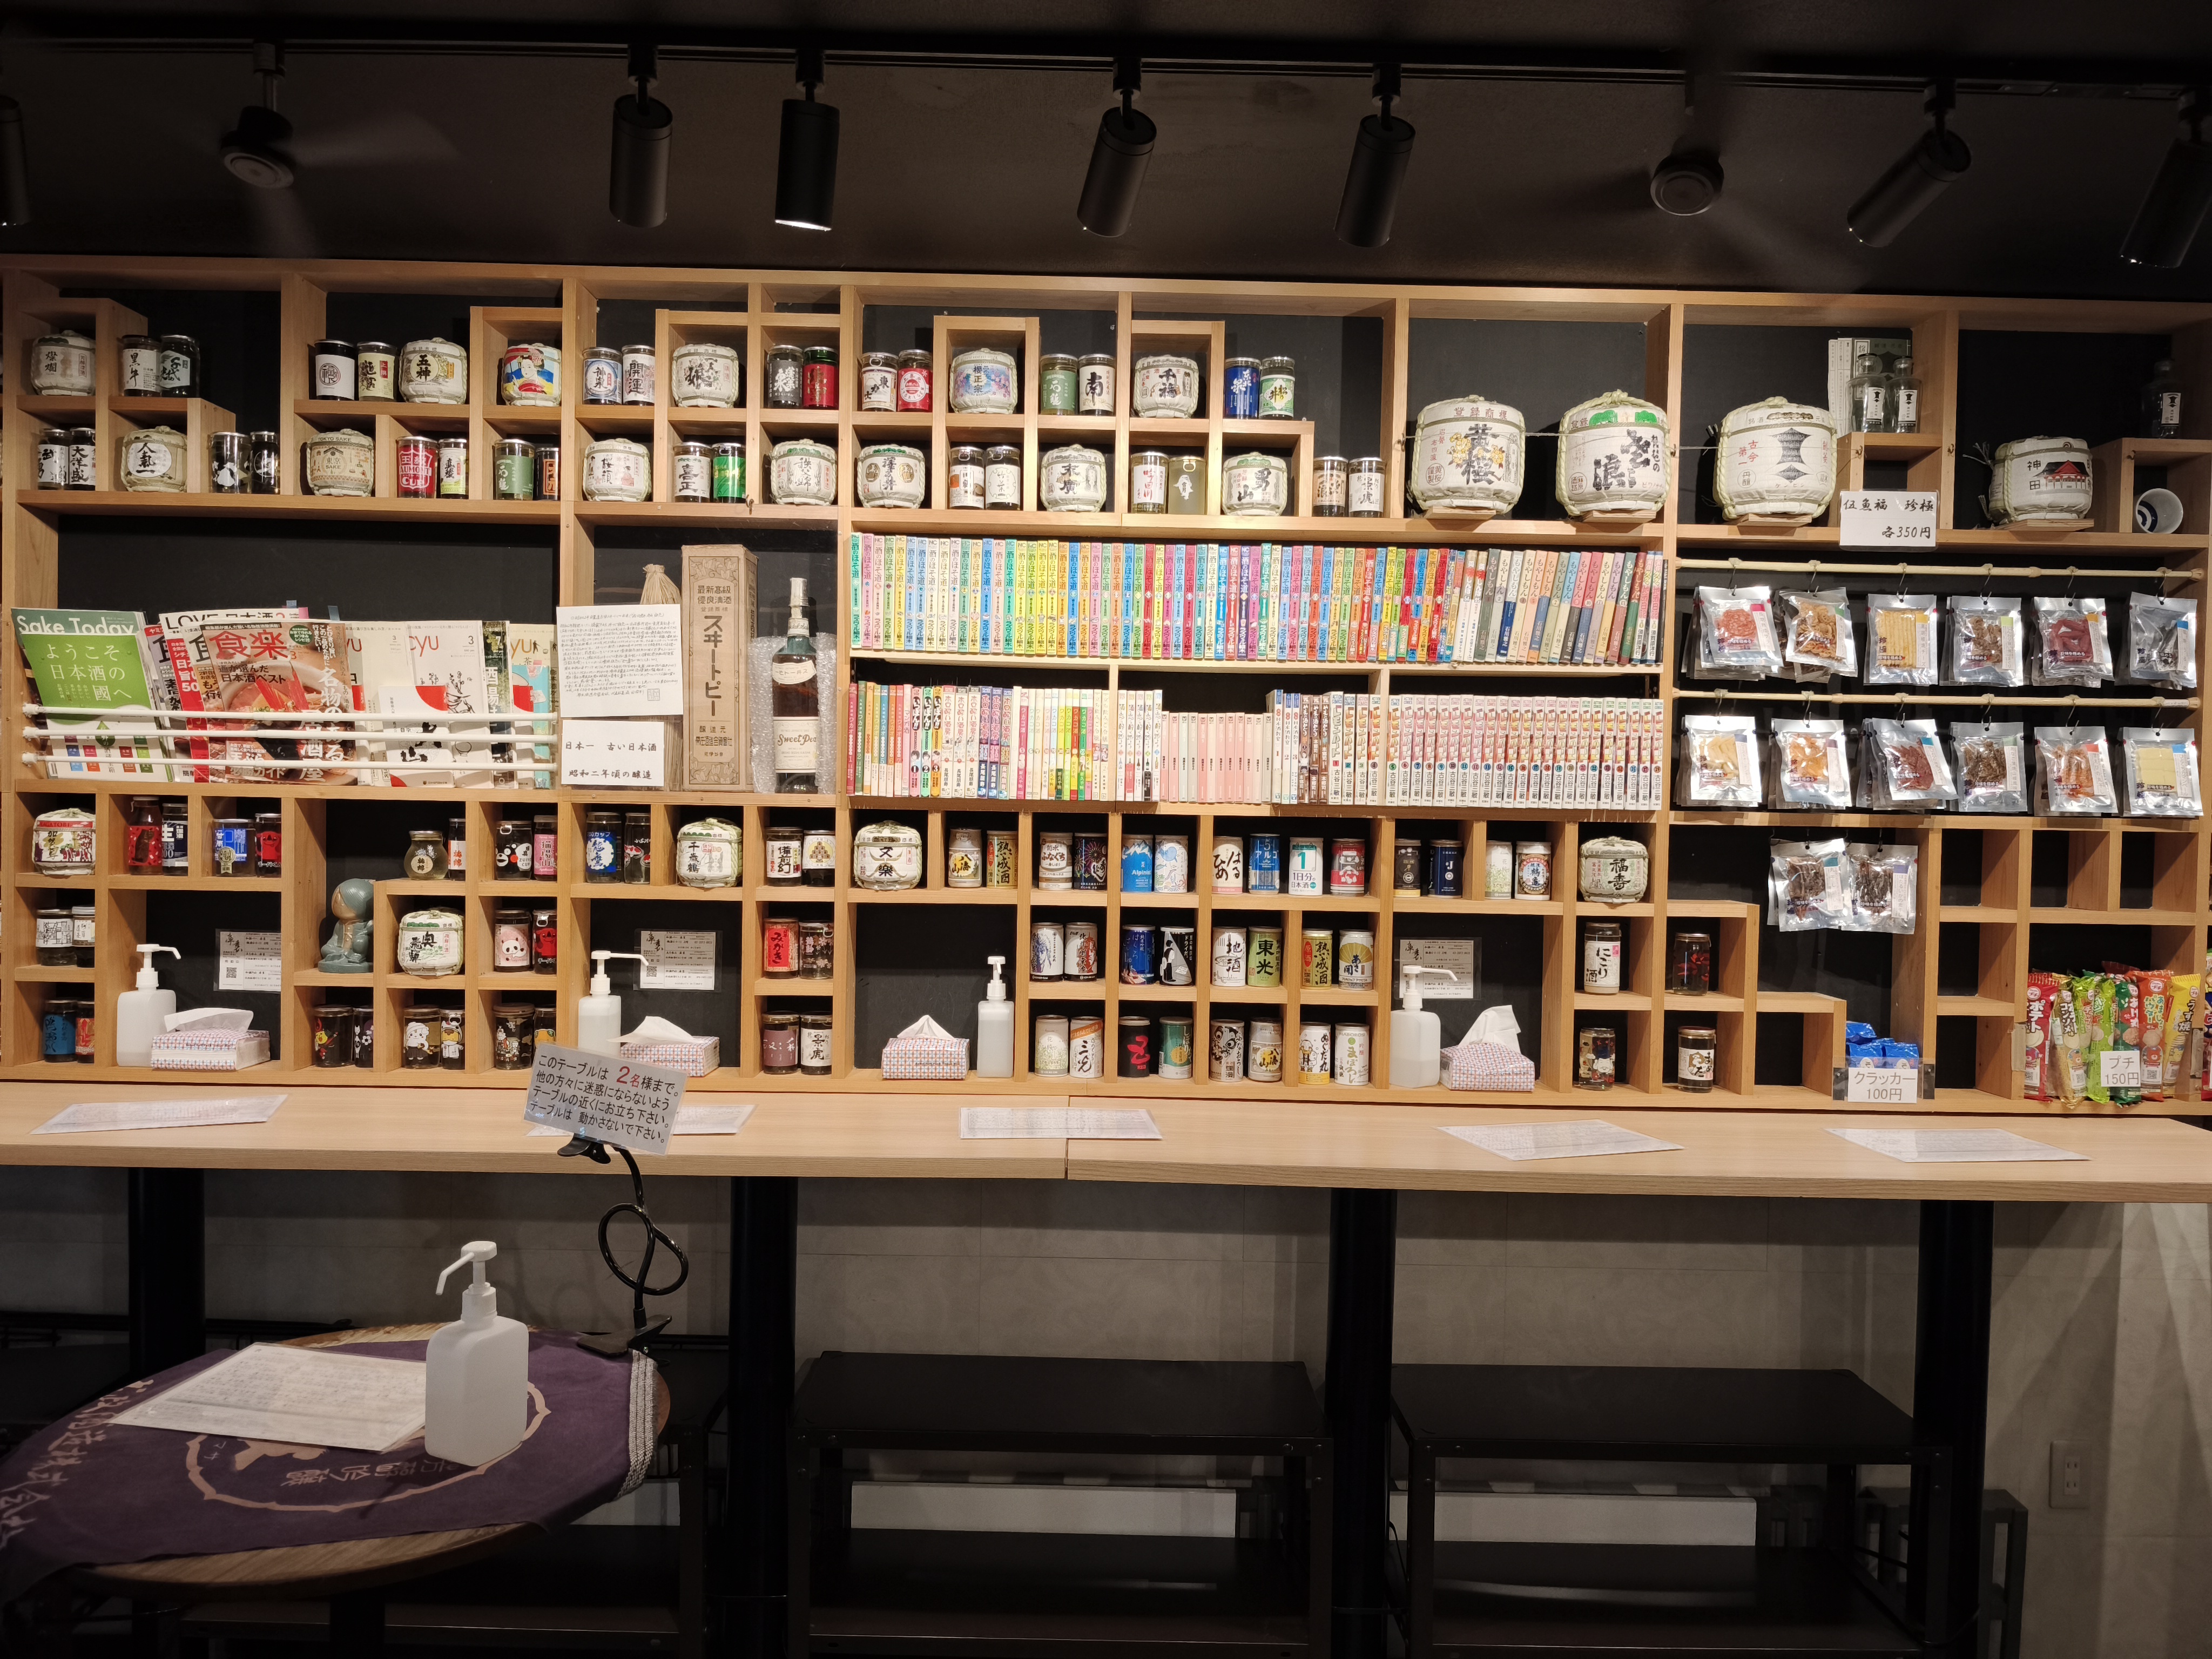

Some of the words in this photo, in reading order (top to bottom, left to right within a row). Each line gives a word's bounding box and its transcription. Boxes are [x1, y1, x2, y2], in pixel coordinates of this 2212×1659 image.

[130, 352, 140, 387] 黒牛
[416, 354, 431, 380] 五神
[629, 362, 645, 394] 開運
[1085, 372, 1103, 406] 南
[71, 446, 89, 482] 大洋盛
[326, 457, 341, 465] 東京
[2027, 460, 2043, 490] 神田
[402, 476, 426, 488] CUP
[678, 463, 698, 493] 喜正
[1237, 468, 1272, 502] 男山
[1843, 498, 1888, 511] 伍魚福
[1881, 524, 1932, 541] 各350円
[1486, 557, 1497, 596] もやしもん
[1520, 559, 1533, 597] もやしもん
[1530, 559, 1543, 597] もやしもん
[1553, 560, 1566, 599] もやしもん
[1563, 561, 1576, 599] もやしもん
[1586, 561, 1598, 599] もやしもん
[1620, 561, 1633, 599] もやしもん
[17, 615, 65, 634] Sake
[68, 617, 134, 634] Today
[46, 643, 120, 661] ようこそ
[208, 629, 288, 659] 食楽
[50, 664, 125, 682] 日本酒の
[221, 674, 286, 684] 日本酒ベスト
[704, 615, 723, 717] スヰートピー
[92, 685, 132, 701] 國へ
[565, 741, 595, 750] 日本一
[606, 741, 657, 752] 古い日本酒
[778, 734, 801, 746] Sweet
[568, 768, 653, 780] 昭和二年頃の醸造
[686, 843, 700, 874] 千歳鶴
[778, 845, 792, 874] 備前幻
[952, 853, 975, 874] 八海山
[996, 841, 1011, 885] 熟成酒
[1041, 851, 1067, 861] ふなぐち
[1297, 851, 1307, 870] 1
[1291, 881, 1309, 889] 日本酒
[410, 931, 436, 963] 奥飛騨
[771, 931, 785, 965] みがき
[1226, 941, 1242, 973] 地酒
[1256, 939, 1274, 976] 東光
[1313, 941, 1330, 985] 熟成酒
[2028, 999, 2046, 1033] ポテト
[811, 1033, 825, 1060] 景虎
[1259, 1048, 1279, 1068] 八海山
[538, 1054, 609, 1080] このテーブルは
[615, 1065, 679, 1097] 2名様まで。
[1345, 1046, 1359, 1084] まぼろし
[2108, 1055, 2134, 1069] プチ
[536, 1069, 670, 1111] 他の方々に迷惑にならないよう
[1853, 1071, 1916, 1086] クラッカー
[2105, 1073, 2140, 1085] 150円
[532, 1085, 669, 1129] テーブルの近くにお立ち下さい。
[1865, 1089, 1903, 1101] 100円
[530, 1102, 572, 1120] テーブルは
[577, 1111, 665, 1143] 動かさないで下さい。
